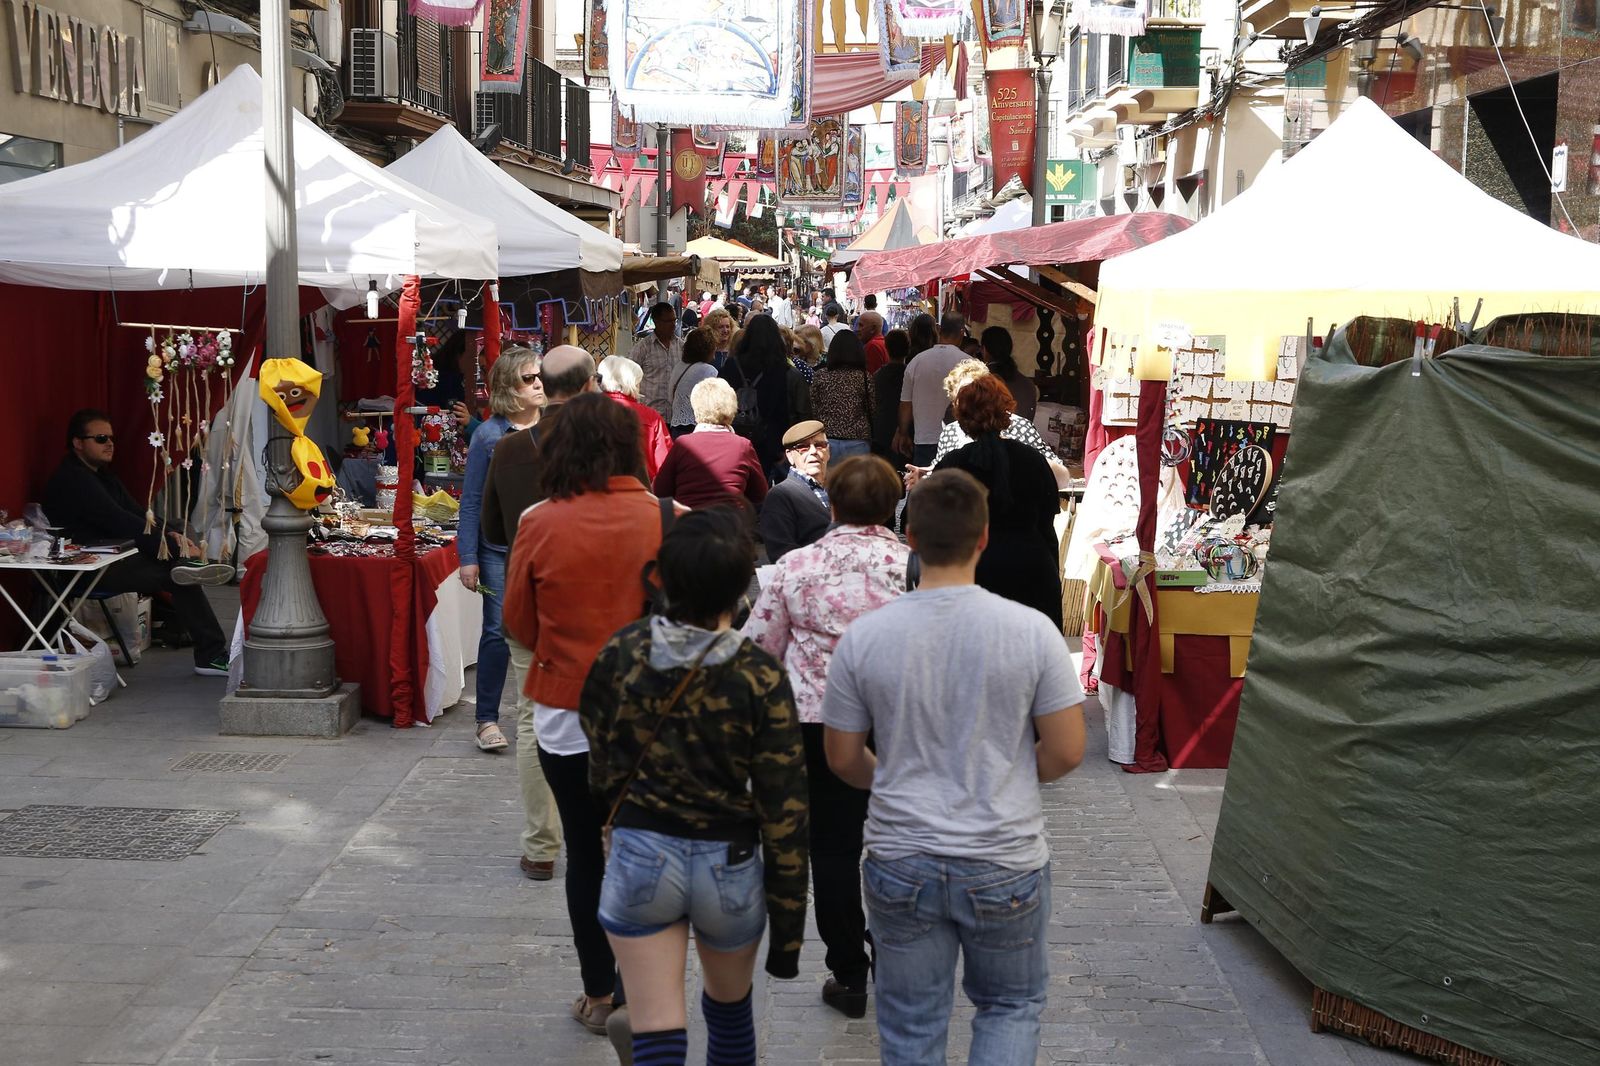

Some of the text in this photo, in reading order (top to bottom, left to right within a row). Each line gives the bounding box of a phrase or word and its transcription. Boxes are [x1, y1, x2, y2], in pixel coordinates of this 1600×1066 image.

[8, 0, 148, 117] VENECIA
[997, 87, 1018, 101] 525
[991, 96, 1033, 109] Aniversario
